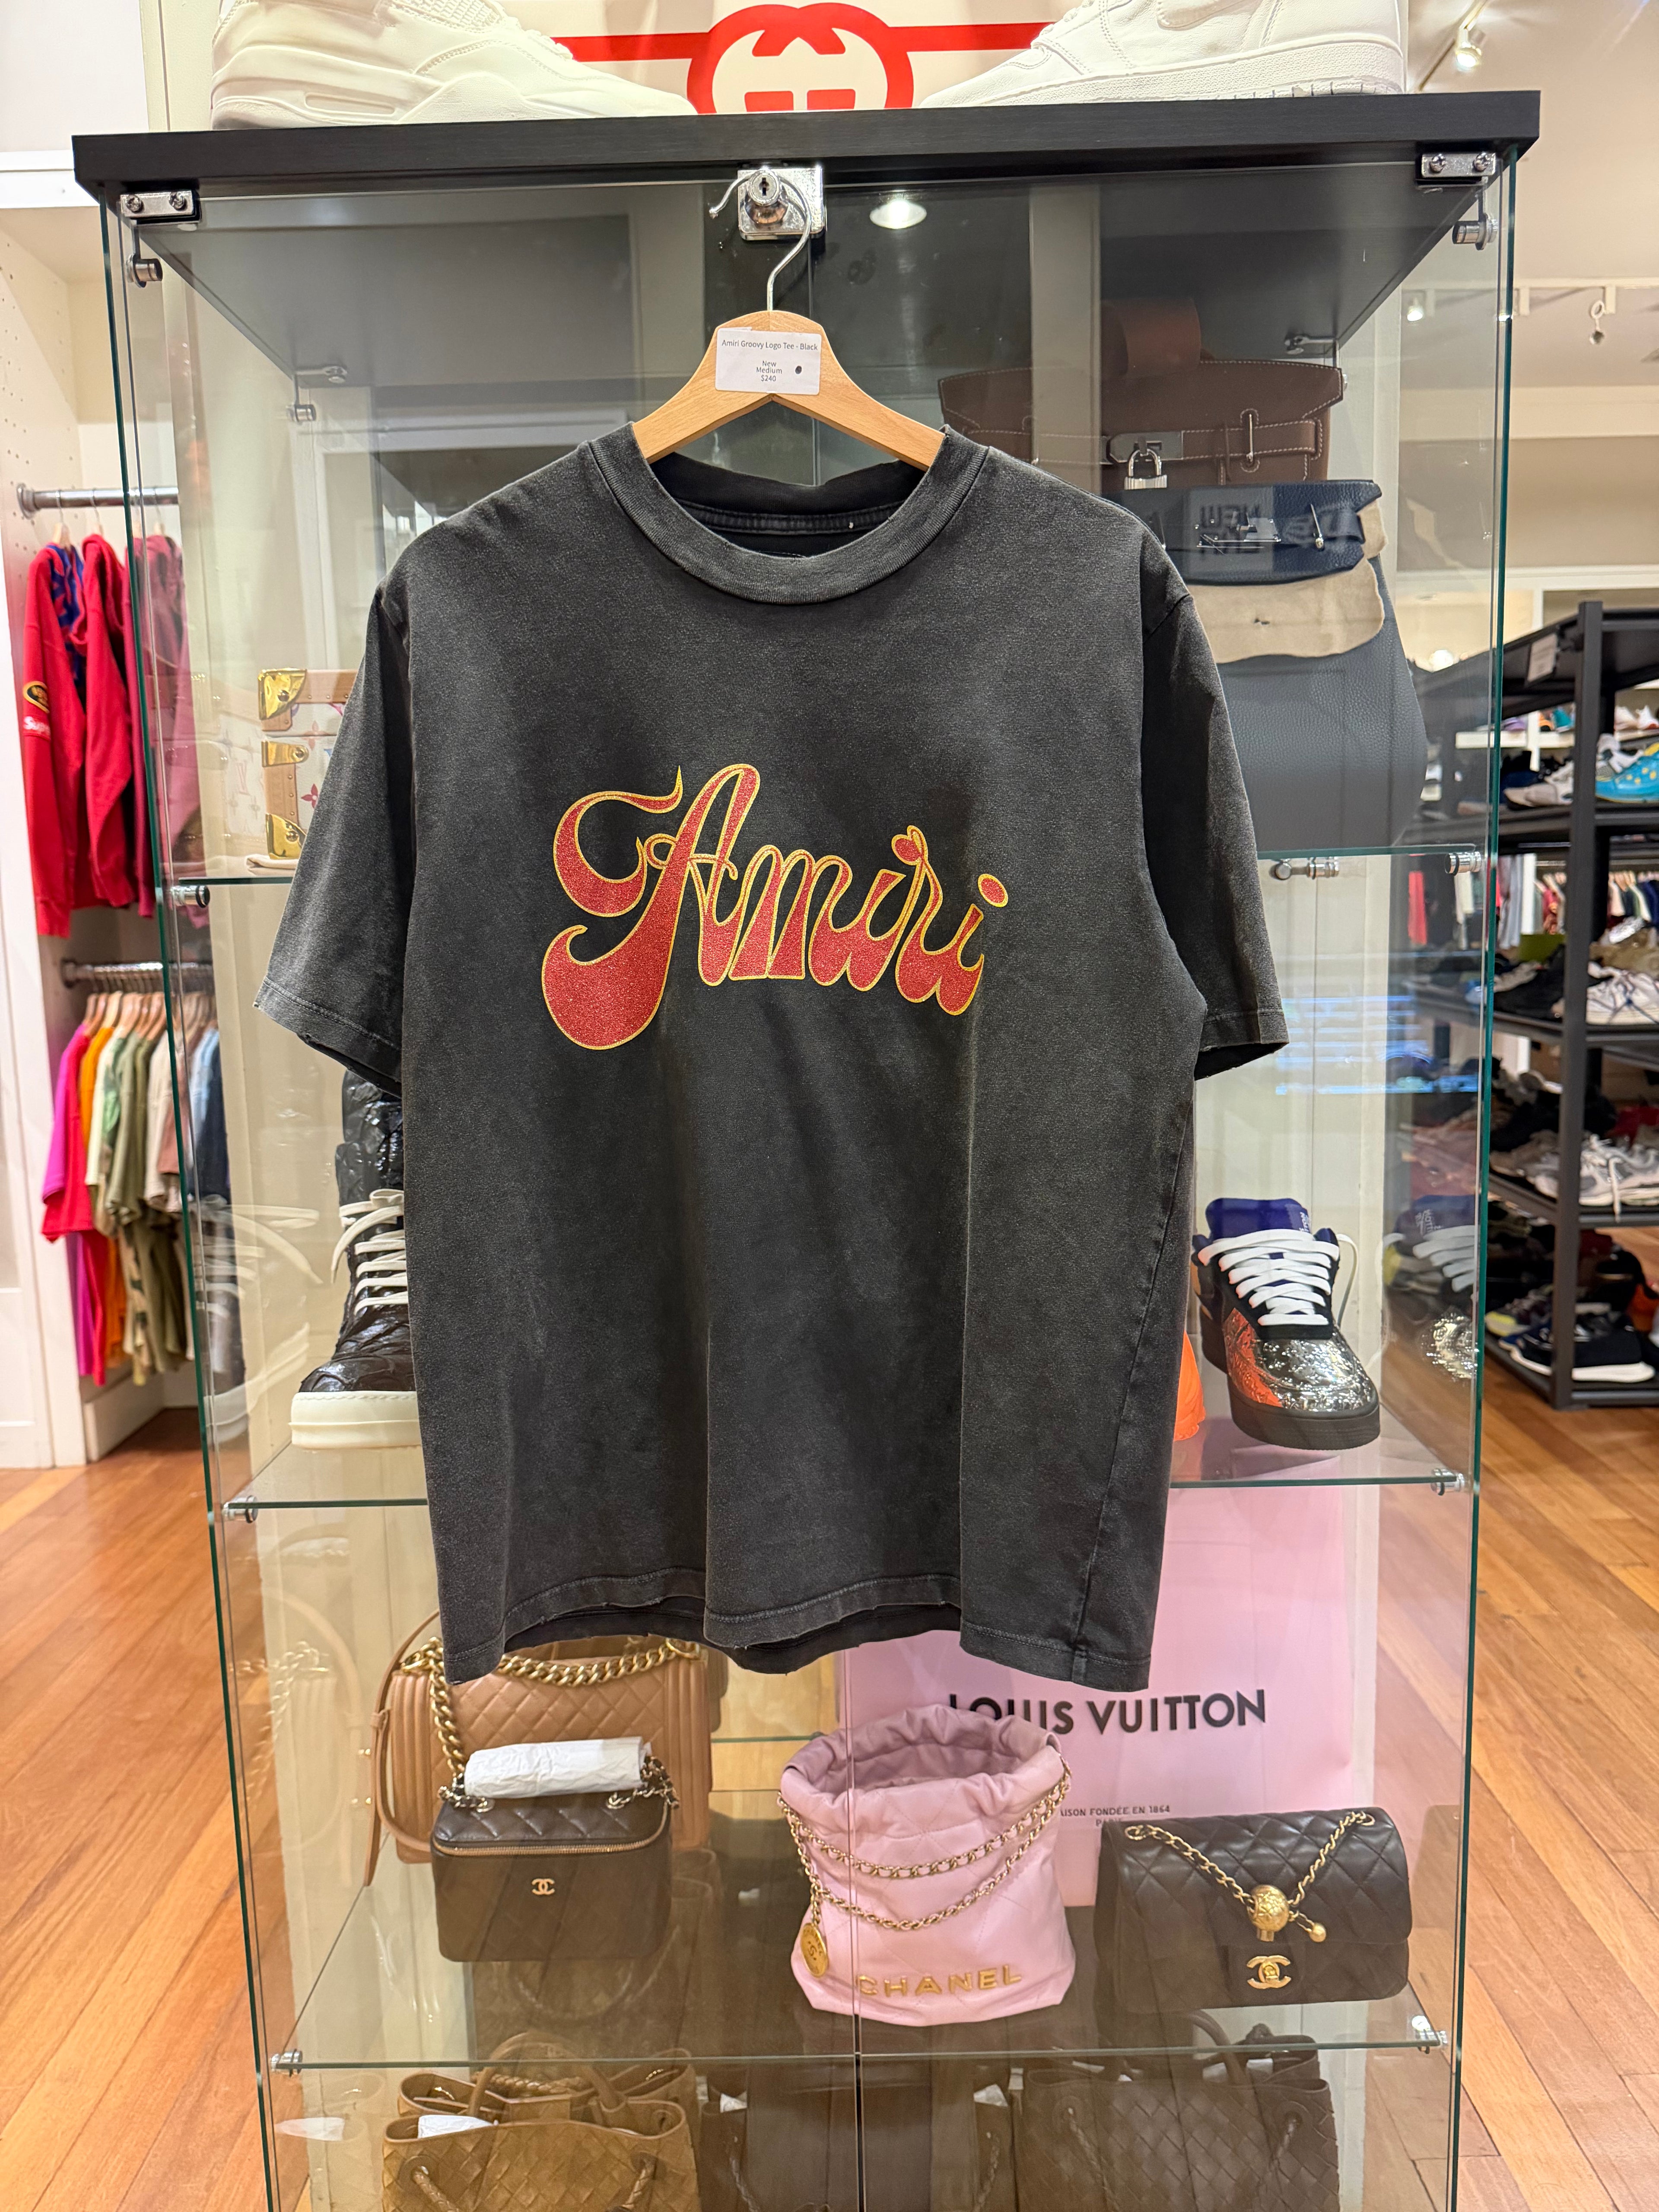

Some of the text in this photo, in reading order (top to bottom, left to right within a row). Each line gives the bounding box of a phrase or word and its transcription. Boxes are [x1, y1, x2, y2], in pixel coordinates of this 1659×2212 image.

[741, 340, 764, 349] Groovy
[766, 342, 781, 350] Logo
[541, 763, 1008, 1050] Amiri
[1087, 1689, 1266, 1734] VUITTON
[1090, 1805, 1129, 1815] FONDÉE
[856, 1965, 1022, 1997] CHANEL
